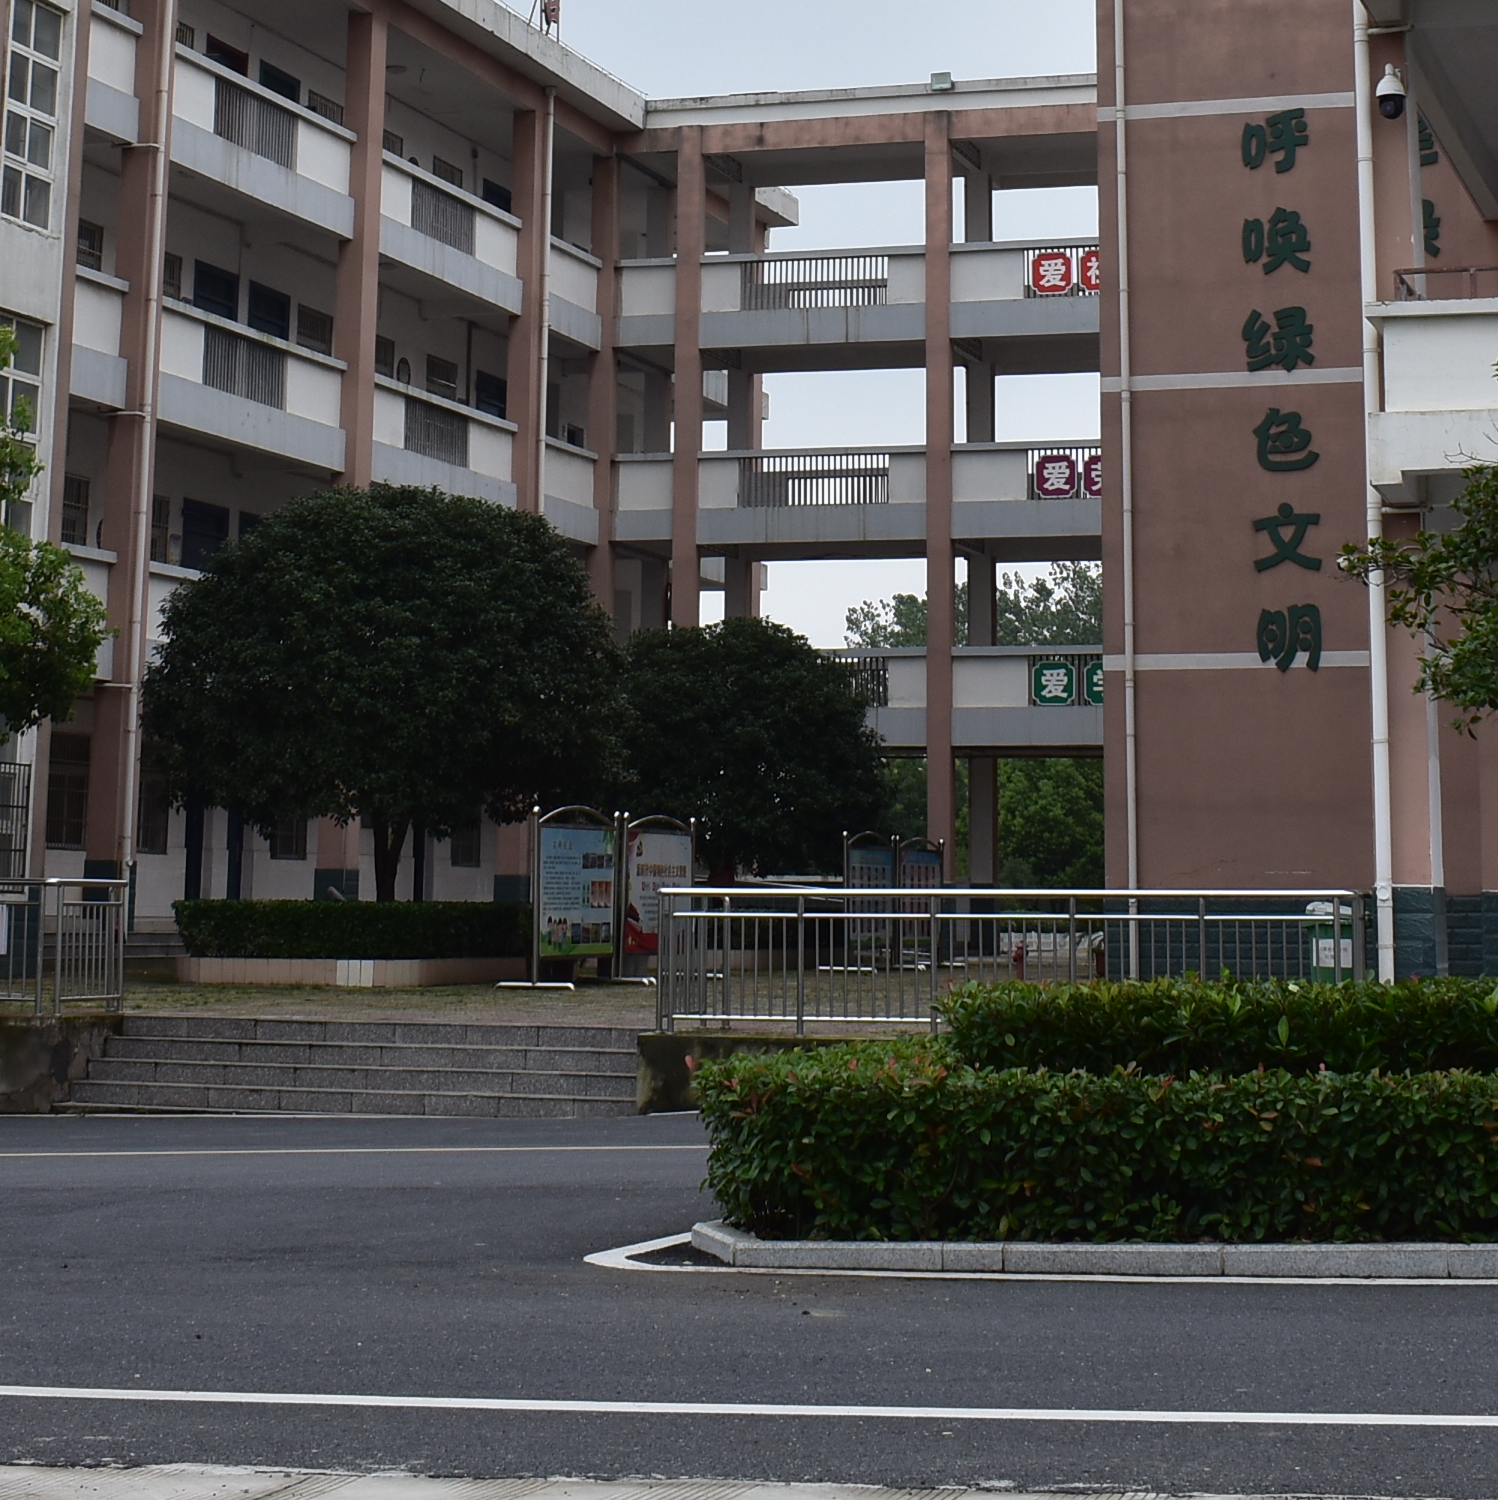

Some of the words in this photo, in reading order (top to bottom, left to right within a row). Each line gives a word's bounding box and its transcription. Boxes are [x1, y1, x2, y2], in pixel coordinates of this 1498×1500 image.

[1241, 107, 1323, 673] 呼唤绿色文明
